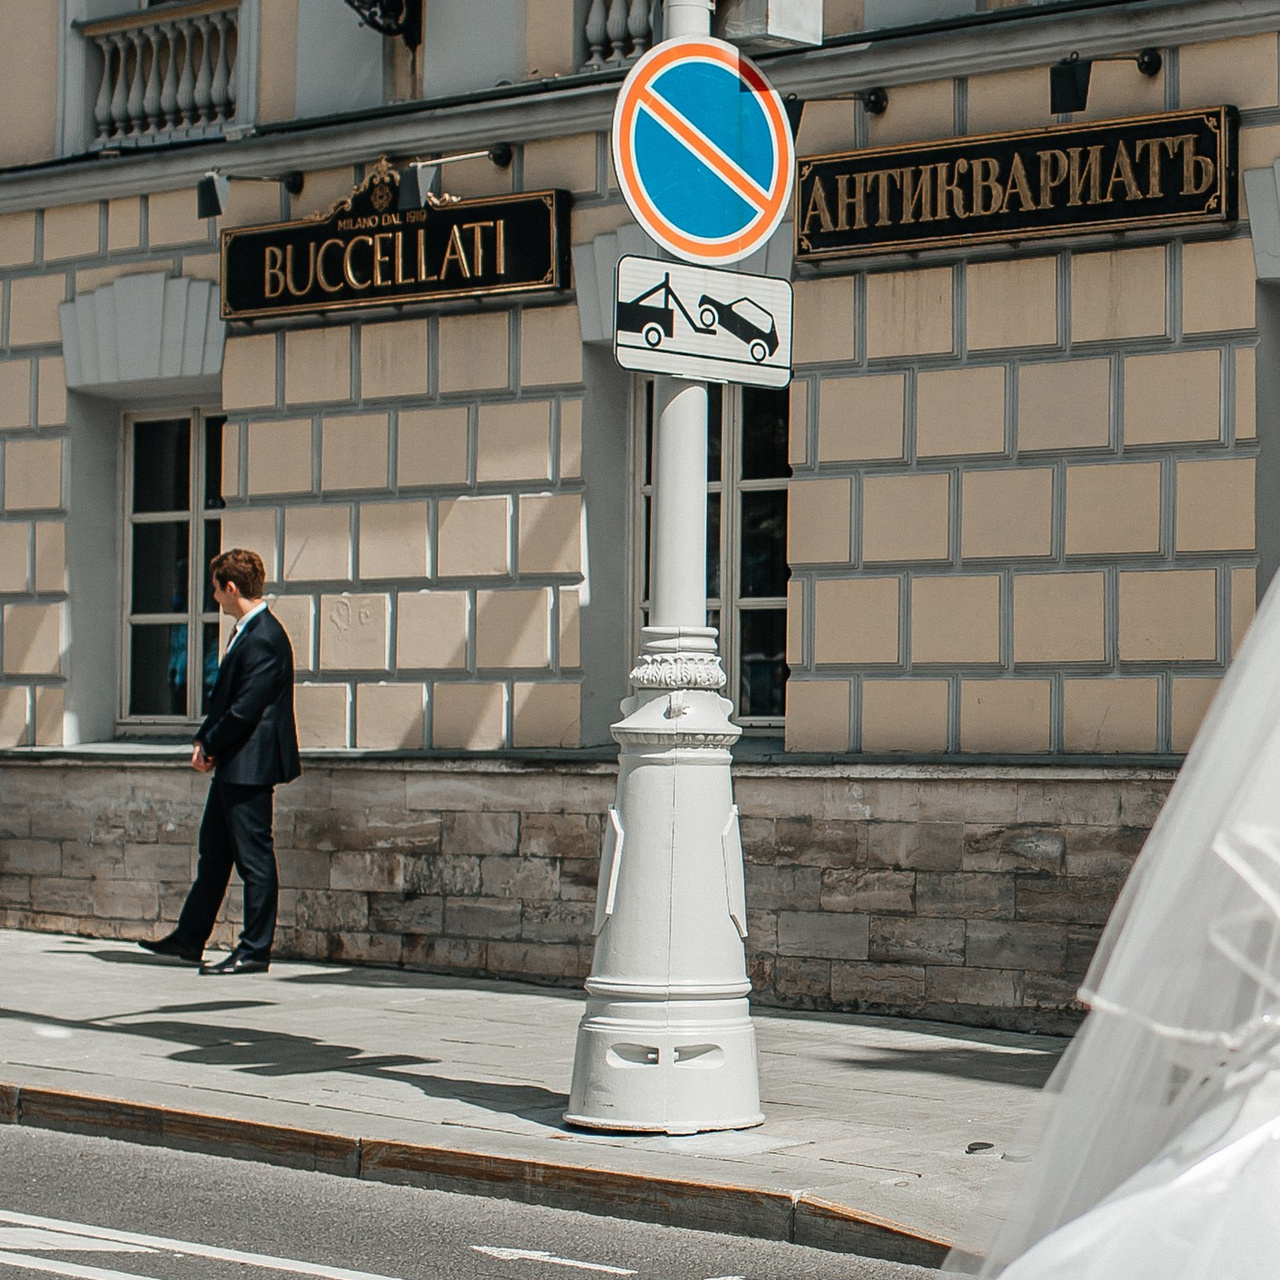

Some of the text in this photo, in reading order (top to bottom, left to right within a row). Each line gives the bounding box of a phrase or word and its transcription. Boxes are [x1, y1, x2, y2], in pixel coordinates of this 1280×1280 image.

[337, 214, 379, 231] MILANO
[381, 212, 403, 227] DAL
[802, 134, 1216, 235] АНТИКВАРИАТЪ
[264, 220, 505, 299] BUCCELLATI
